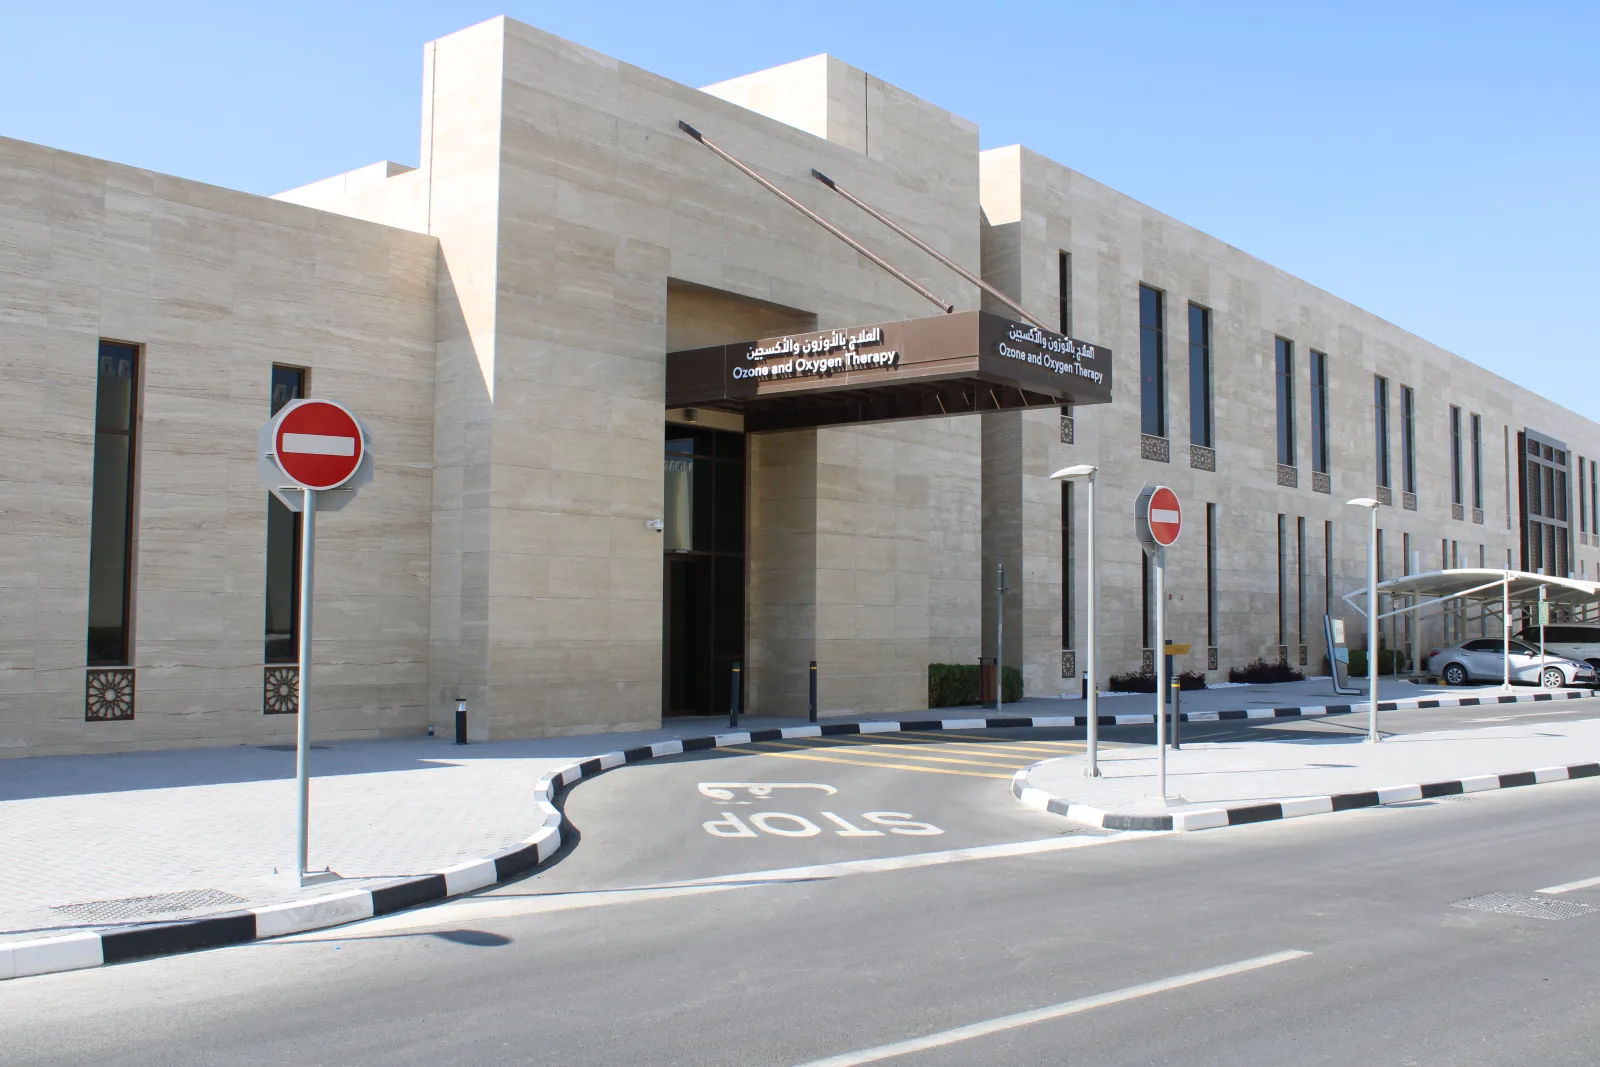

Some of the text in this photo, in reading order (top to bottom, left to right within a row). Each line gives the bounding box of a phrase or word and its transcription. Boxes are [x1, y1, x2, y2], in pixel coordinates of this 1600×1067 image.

[747, 328, 881, 361] العلاج بالأوزون والأكسجين
[1009, 324, 1095, 361] العلاج بالأوزون والأكسجين
[733, 350, 896, 379] Ozone and Oxygen Therapy
[999, 342, 1104, 385] Ozone and Oxygen Therapy
[702, 811, 946, 838] STOP
